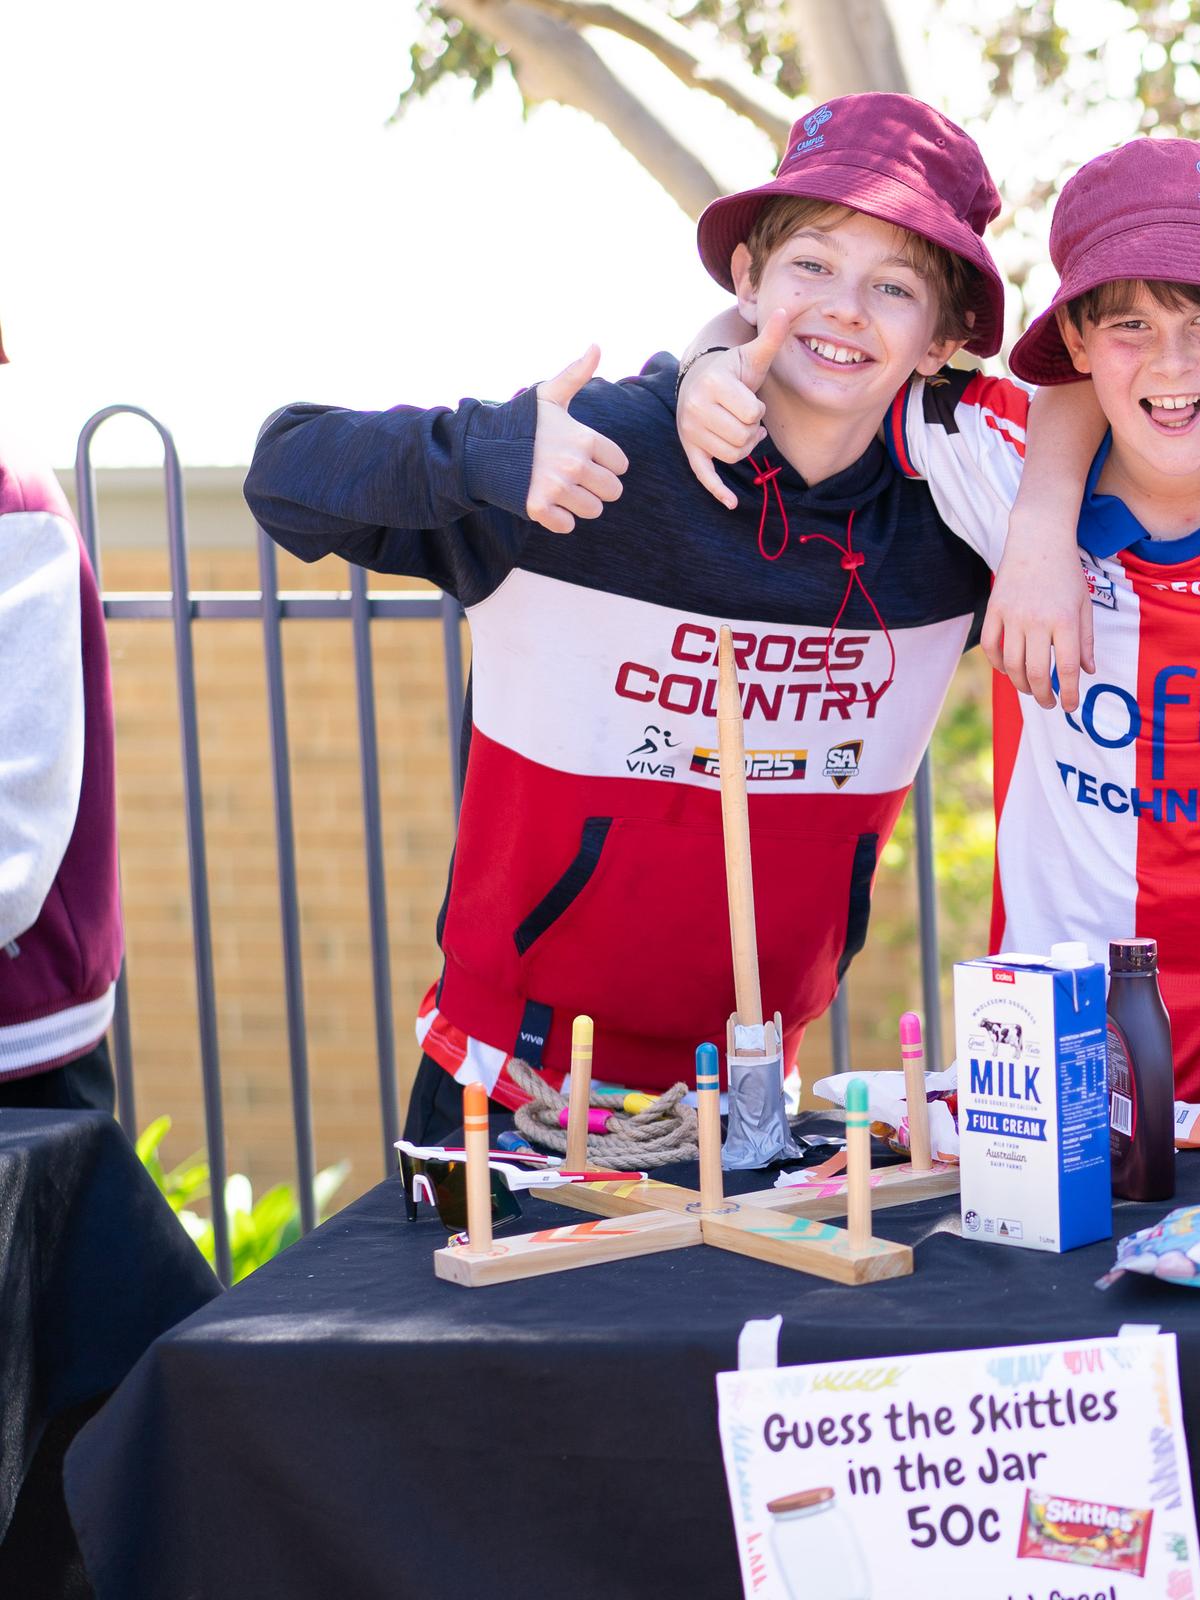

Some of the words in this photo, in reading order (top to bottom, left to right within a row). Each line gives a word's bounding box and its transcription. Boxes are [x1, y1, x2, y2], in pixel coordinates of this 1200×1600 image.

[671, 623, 870, 673] CROSS
[704, 752, 797, 778] 225
[827, 749, 858, 768] SA
[970, 1058, 1042, 1105] MILK
[972, 1114, 999, 1131] FULL
[1002, 1117, 1040, 1137] CREAM
[985, 1148, 1028, 1163] Australian
[763, 1413, 873, 1452] Guess
[885, 1401, 956, 1442] the
[970, 1389, 1119, 1435] Skittles
[847, 1459, 881, 1496] in
[894, 1452, 966, 1492] the
[978, 1447, 1047, 1485] Jar
[908, 1504, 1001, 1548] 50c
[1046, 1499, 1134, 1533] Skittles
